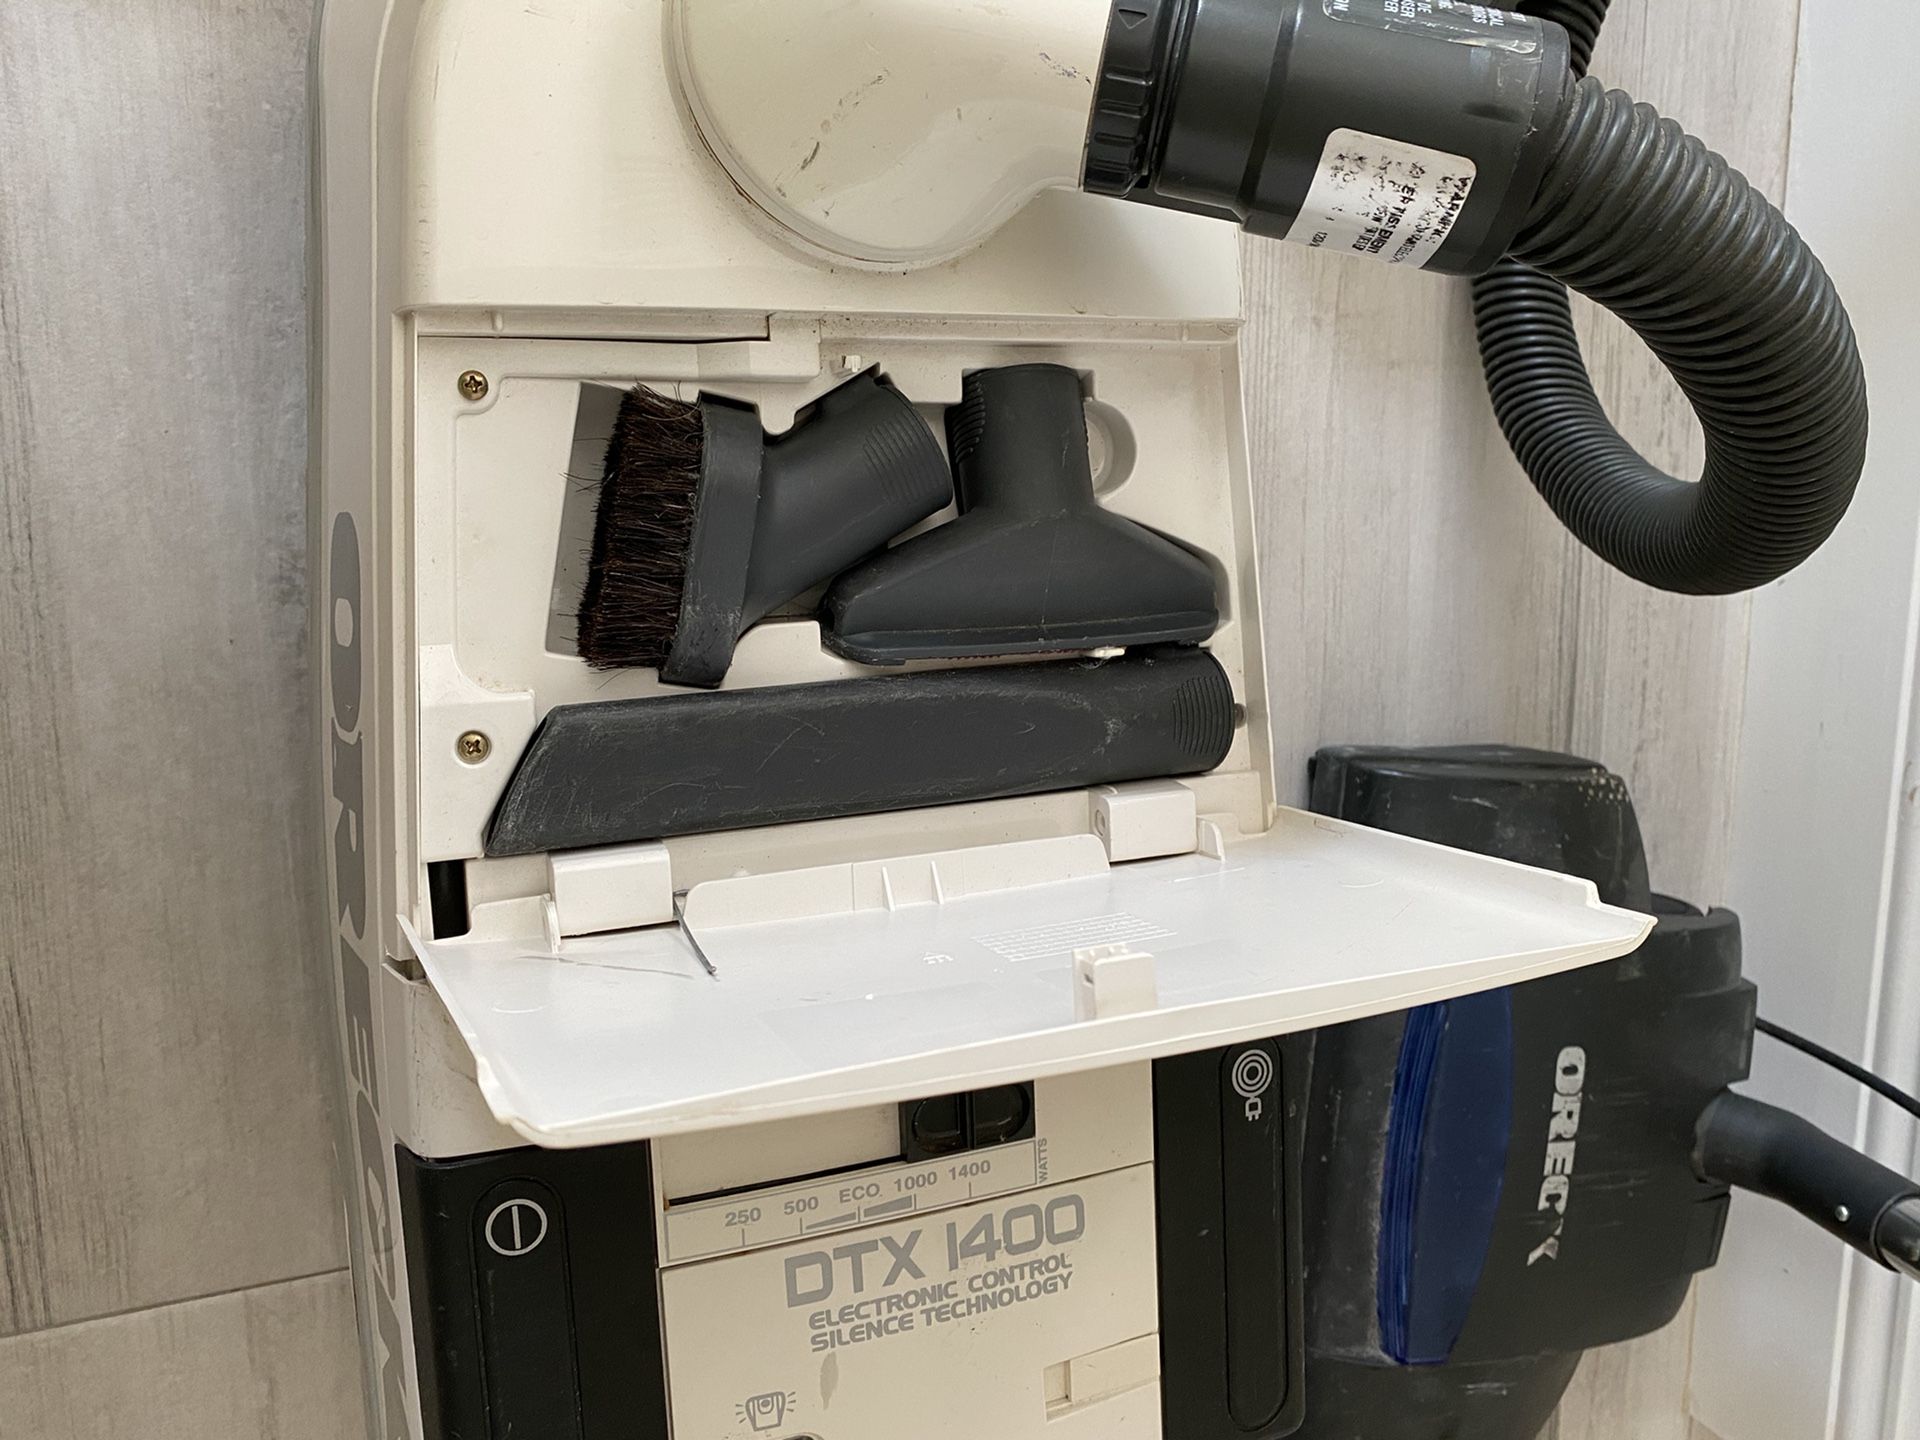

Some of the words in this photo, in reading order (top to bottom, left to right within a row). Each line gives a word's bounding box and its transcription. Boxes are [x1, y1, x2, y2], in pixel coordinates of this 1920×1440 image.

[724, 1206, 762, 1227] 250
[783, 1196, 819, 1216] 500
[893, 1171, 938, 1193] 1000
[949, 1160, 992, 1181] 1400
[1038, 1137, 1049, 1184] WATTS
[784, 1229, 926, 1308] DTX
[946, 1193, 1086, 1272] 1400
[808, 1280, 958, 1330] ELECTRONIC
[967, 1252, 1073, 1293] CONTROL
[810, 1312, 914, 1353] SILENCE
[920, 1271, 1073, 1327] TECHNOLOGY
